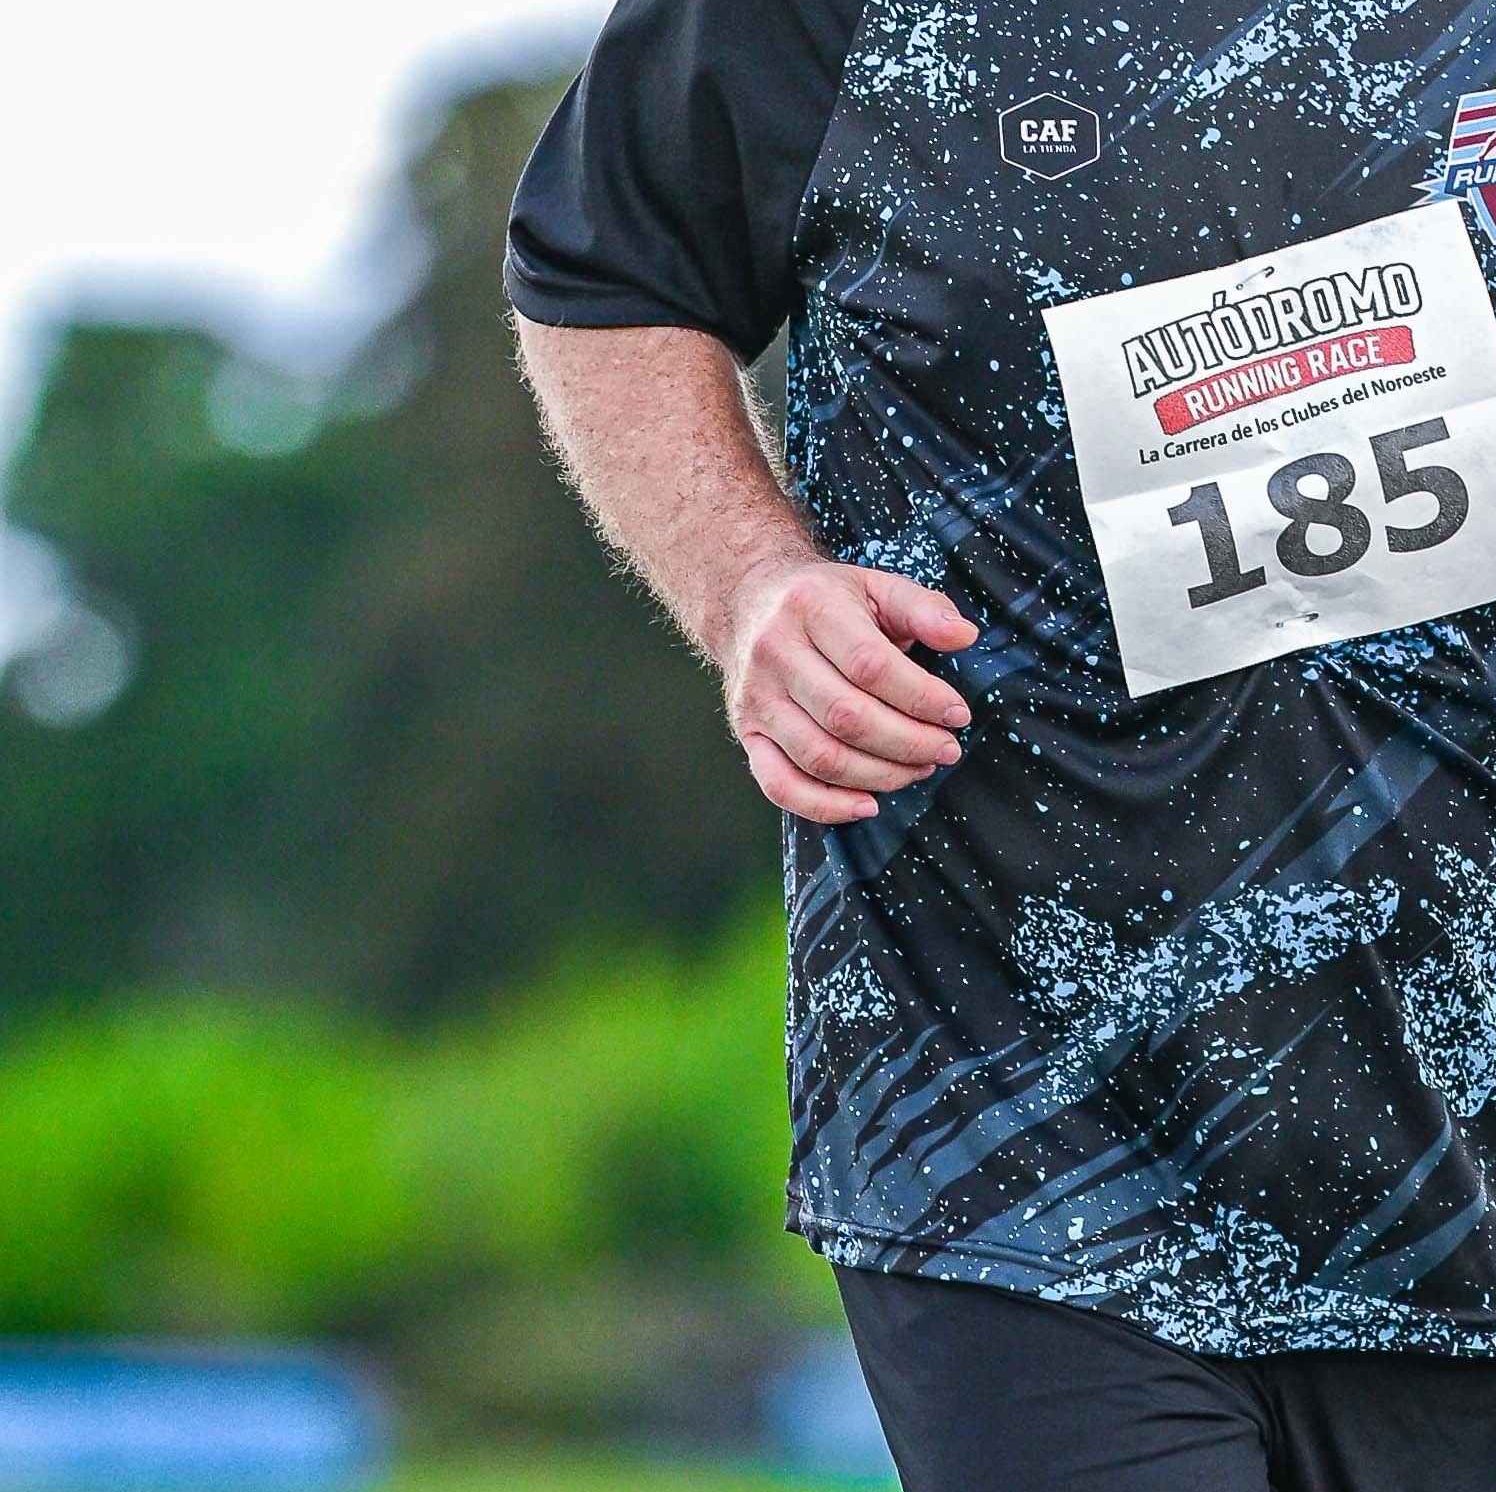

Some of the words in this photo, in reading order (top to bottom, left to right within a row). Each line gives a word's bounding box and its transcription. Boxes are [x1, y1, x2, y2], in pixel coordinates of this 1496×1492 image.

[1020, 119, 1078, 142] CAF
[1022, 144, 1037, 154] LA
[1039, 144, 1077, 154] TIENDA
[1122, 263, 1422, 399] AUTÓDROMO
[1138, 448, 1160, 466] La
[1163, 431, 1228, 459] Carrera
[1231, 421, 1254, 440] de
[1255, 416, 1280, 435] los
[1281, 397, 1339, 427] Clubes
[1342, 381, 1370, 406] del
[1371, 365, 1447, 396] Noroeste
[1183, 355, 1301, 422] RUNNING
[1307, 336, 1384, 378] RACE
[1167, 416, 1469, 610] 185
